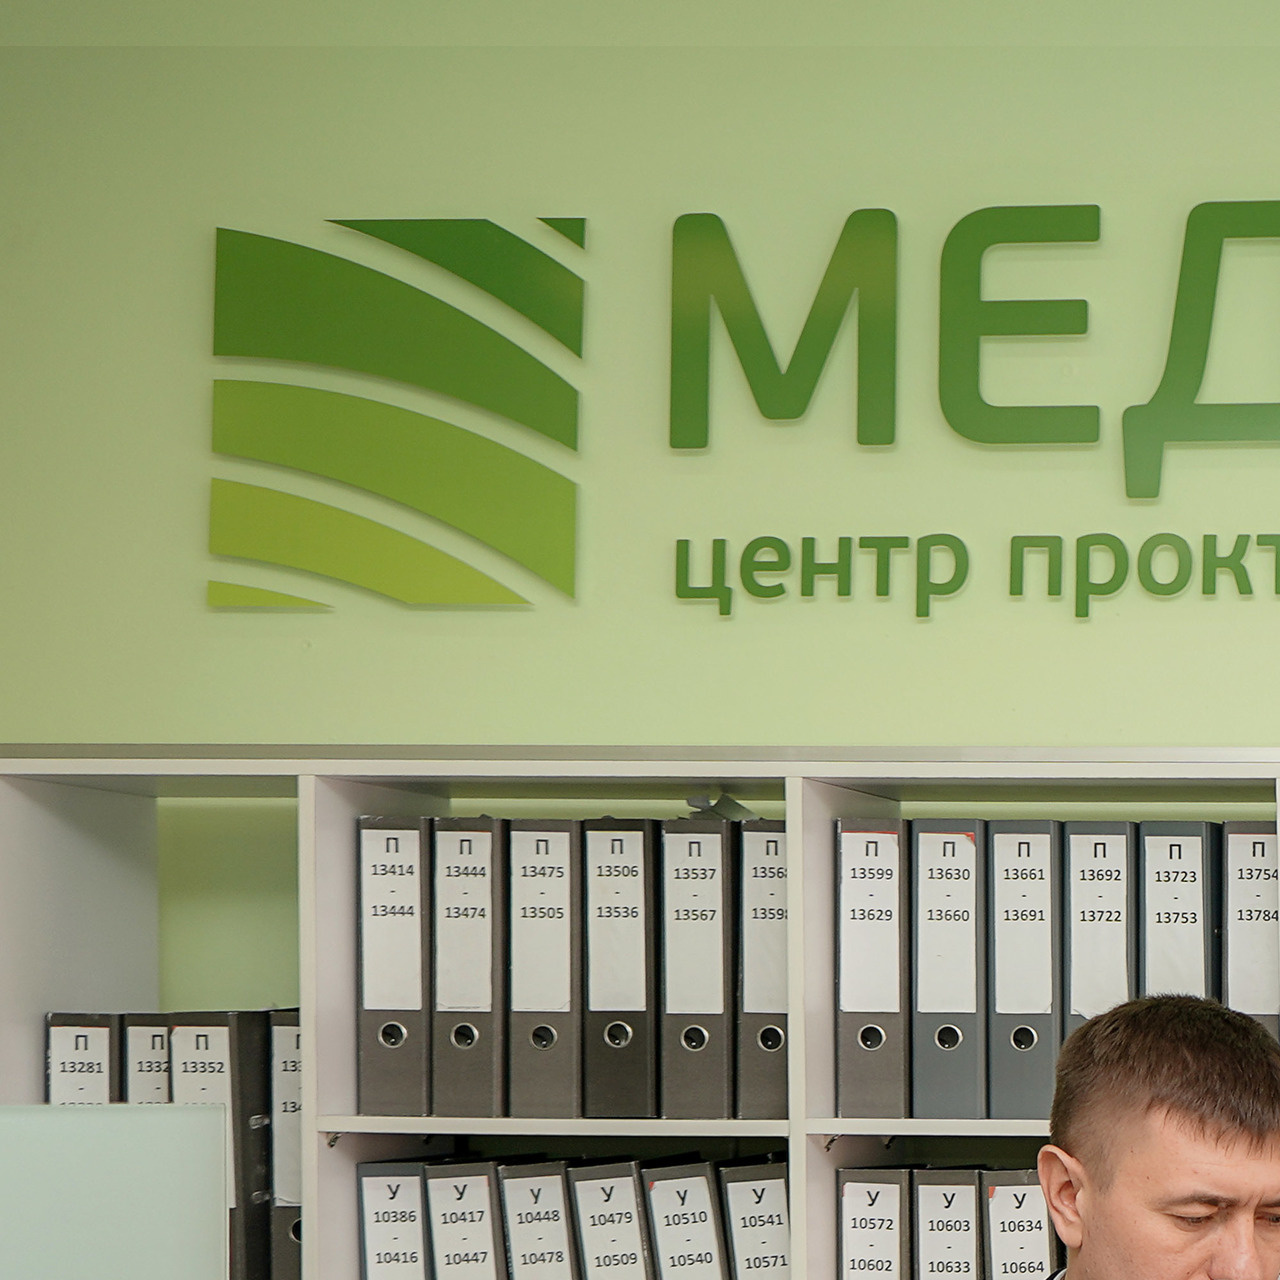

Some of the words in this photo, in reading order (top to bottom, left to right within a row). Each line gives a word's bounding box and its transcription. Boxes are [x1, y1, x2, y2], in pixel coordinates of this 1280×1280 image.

[675, 534, 969, 617] центр
[372, 864, 414, 875] 13414
[446, 866, 486, 877] 13444
[522, 866, 564, 878] 13475
[597, 866, 638, 877] 13506
[675, 868, 716, 879] 13537
[851, 868, 893, 880] 13599
[929, 868, 970, 880] 13630
[1004, 869, 1044, 880] 13661
[1080, 869, 1121, 881] 13692
[1238, 868, 1278, 880] 13754
[1156, 871, 1196, 882] 13723
[372, 905, 414, 916] 13444
[446, 907, 486, 918] 13474
[521, 907, 563, 919] 13505
[597, 907, 638, 918] 13536
[675, 909, 716, 921] 13567
[851, 909, 892, 921] 13629
[928, 909, 969, 921] 13660
[1004, 910, 1045, 921] 13691
[1081, 911, 1121, 922] 13722
[1237, 909, 1278, 921] 13784
[1156, 912, 1197, 923] 13753
[75, 1035, 88, 1050] П
[196, 1034, 208, 1050] П
[61, 1062, 103, 1073] 13281
[182, 1062, 224, 1073] 13352
[374, 1211, 416, 1222] 10386
[441, 1211, 484, 1224] 10417
[517, 1210, 560, 1224] 10448
[590, 1212, 632, 1226] 10479
[664, 1211, 707, 1226] 10510
[741, 1214, 783, 1228] 10541
[852, 1218, 893, 1230] 10572
[929, 1220, 970, 1231] 10603
[1000, 1220, 1042, 1232] 10634
[376, 1252, 418, 1263] 10416
[445, 1252, 487, 1265] 10447
[521, 1251, 564, 1265] 10478
[595, 1253, 637, 1267] 10509
[669, 1252, 712, 1267] 10540
[745, 1255, 788, 1269] 10571
[850, 1259, 892, 1271] 10602
[929, 1261, 970, 1273] 10633
[1002, 1261, 1044, 1273] 10664
